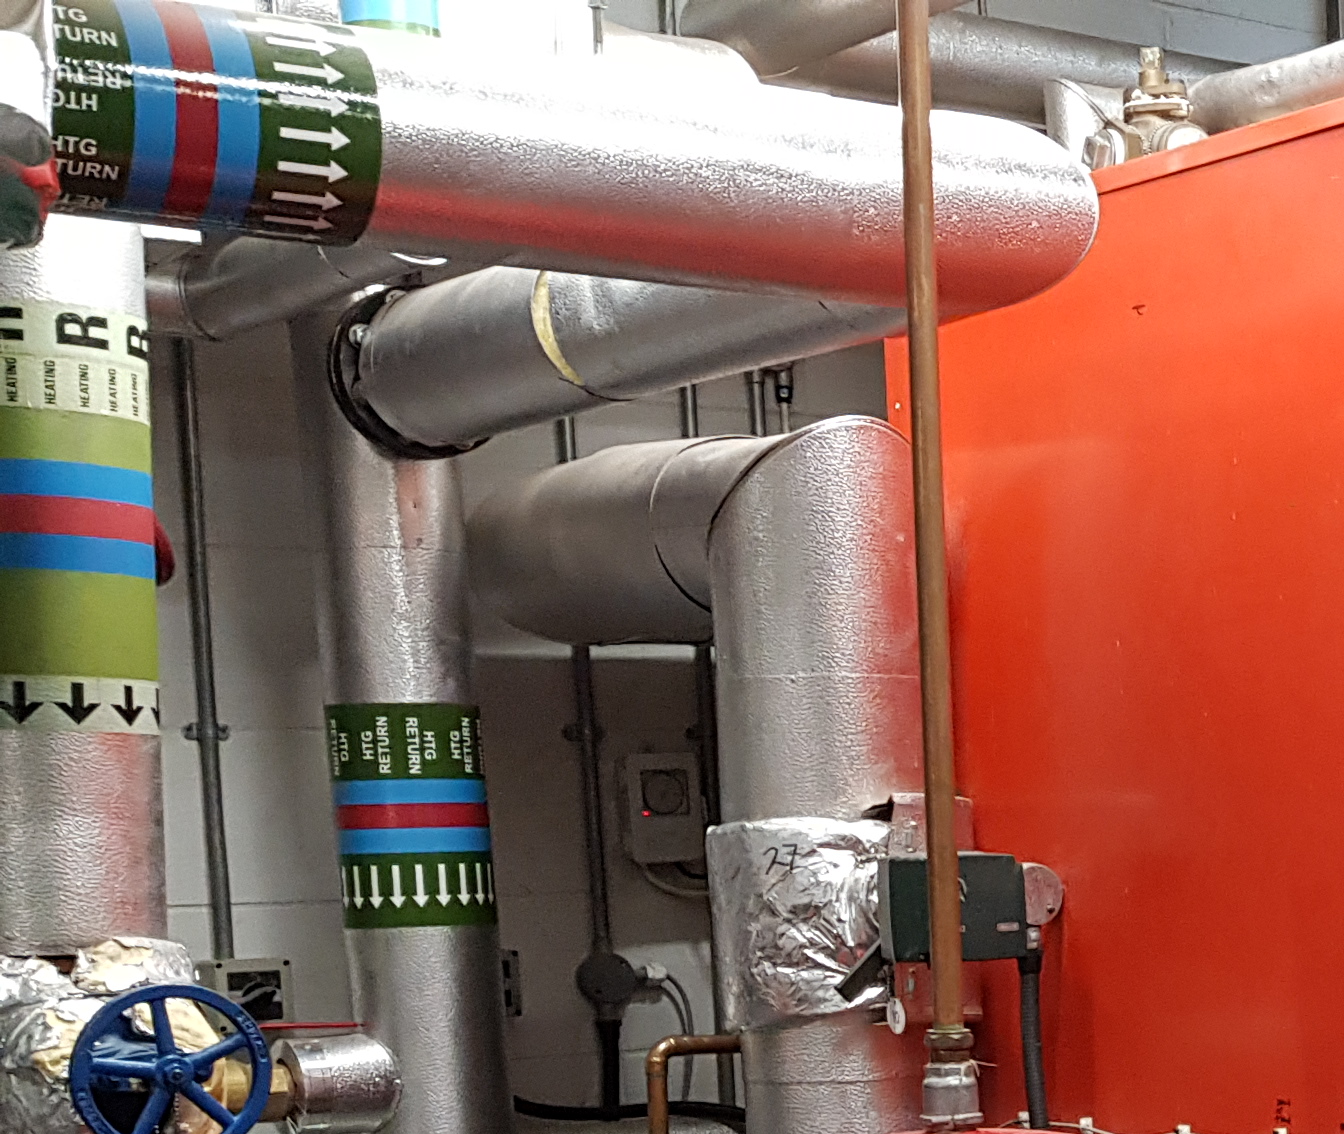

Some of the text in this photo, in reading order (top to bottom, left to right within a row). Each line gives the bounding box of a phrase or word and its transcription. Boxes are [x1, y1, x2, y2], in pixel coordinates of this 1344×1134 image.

[52, 5, 88, 23] TG
[53, 23, 119, 48] TURN
[56, 64, 122, 90] RETU
[56, 158, 119, 181] TURN
[55, 312, 109, 351] R
[4, 357, 18, 402] HEATING
[43, 359, 56, 405] HEATING
[78, 364, 90, 408] HEATING
[338, 732, 349, 762] HTG
[361, 730, 374, 760] HTG
[375, 716, 392, 774] RETURN
[405, 717, 422, 774] RETURN
[423, 730, 437, 760] HTG
[450, 730, 462, 760] HTG
[461, 717, 473, 773] RETURN
[763, 843, 801, 875] 27
